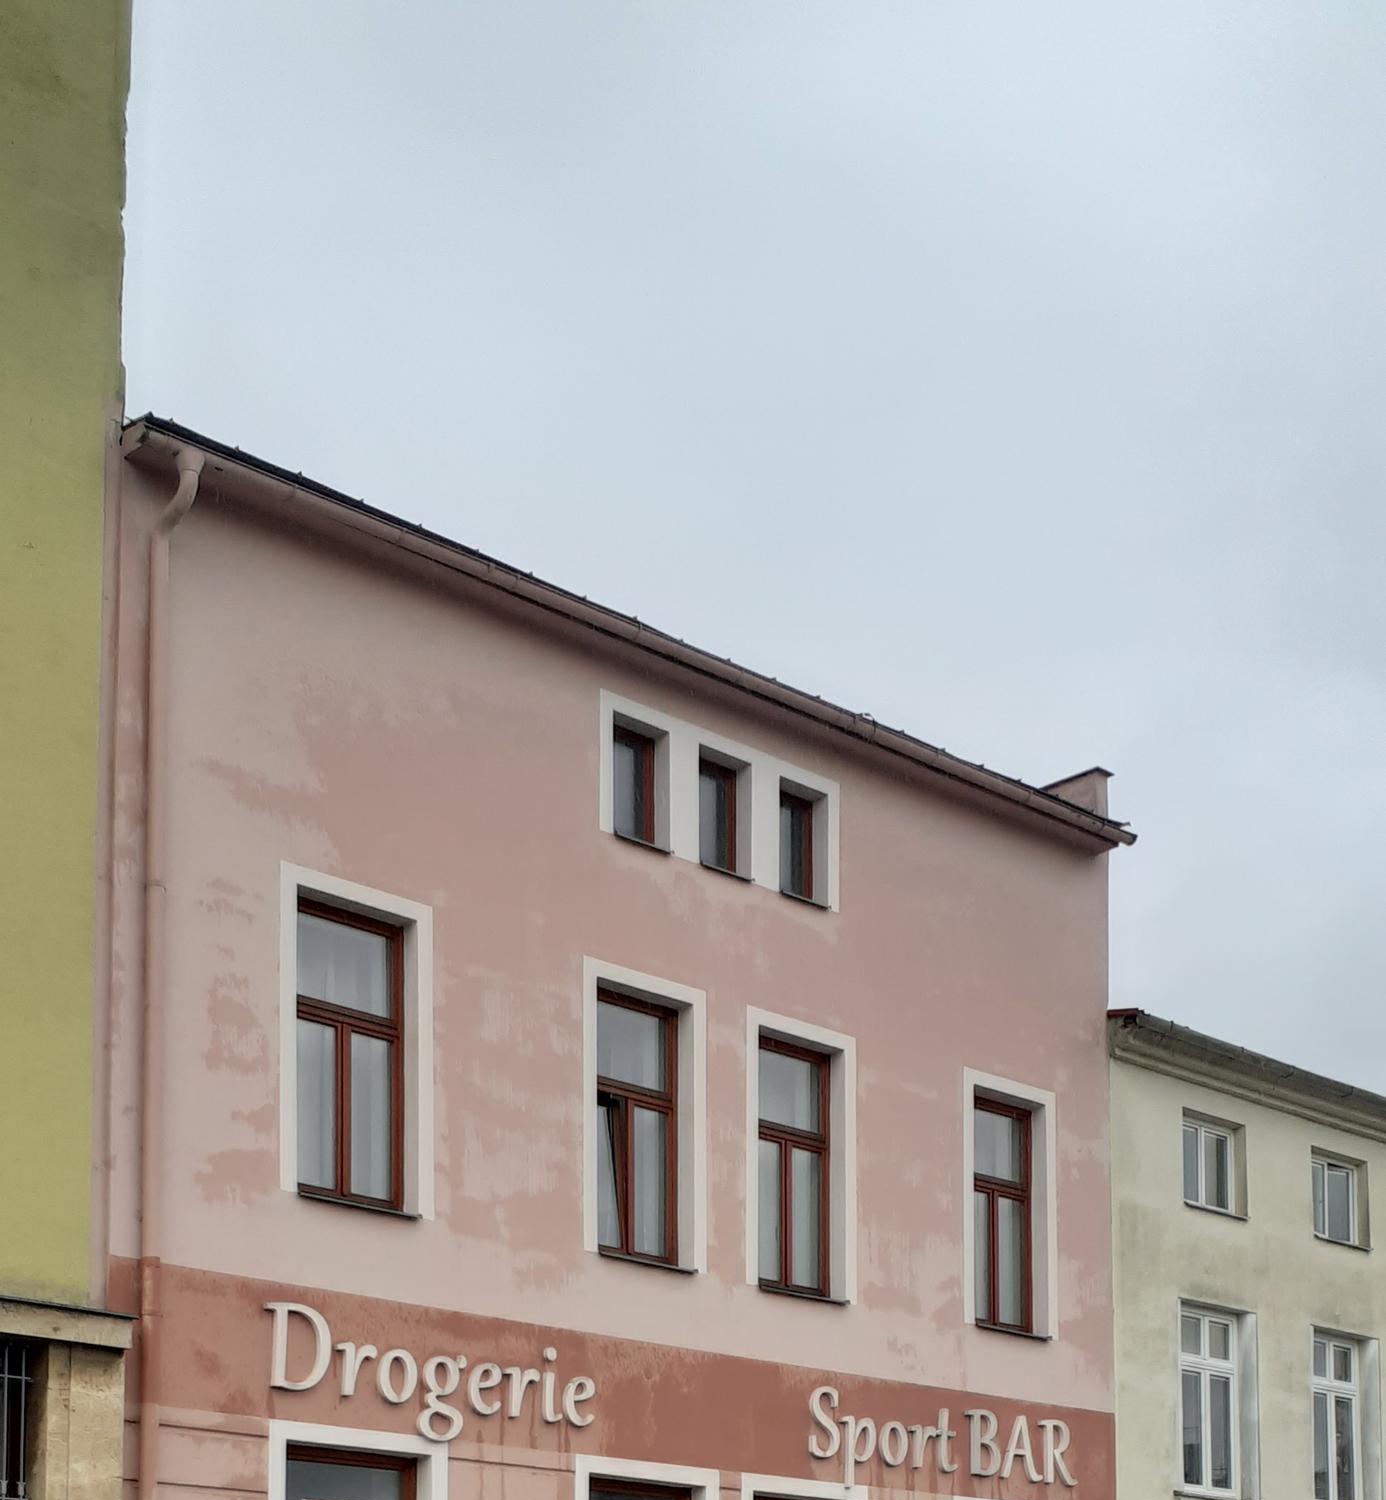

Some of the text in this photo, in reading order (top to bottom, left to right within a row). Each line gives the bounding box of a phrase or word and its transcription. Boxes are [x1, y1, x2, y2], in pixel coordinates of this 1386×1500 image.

[263, 1301, 597, 1443] Drogerie
[808, 1385, 1079, 1489] Sport BAR
